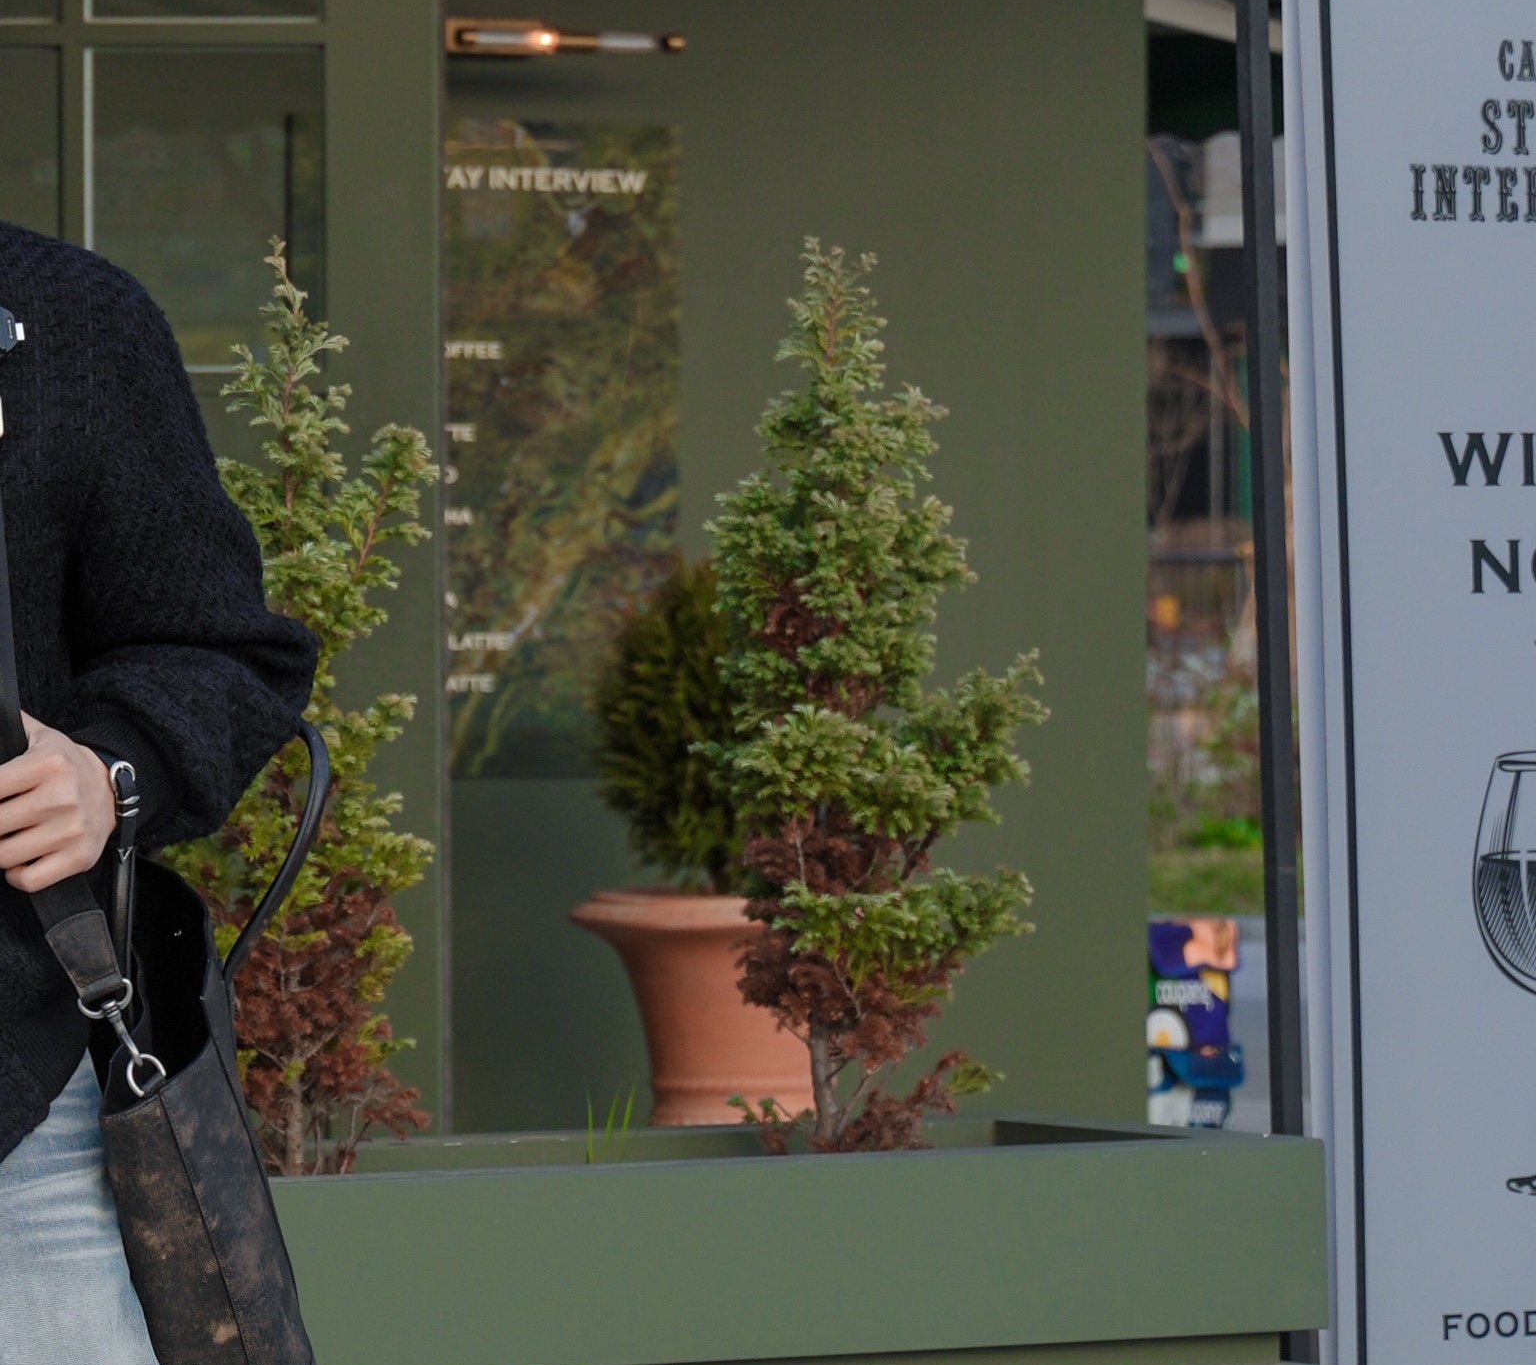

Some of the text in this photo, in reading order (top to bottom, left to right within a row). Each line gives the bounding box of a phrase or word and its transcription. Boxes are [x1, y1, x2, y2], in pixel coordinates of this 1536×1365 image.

[444, 165, 648, 195] AY INTERVIEW
[1155, 979, 1215, 1013] coupang
